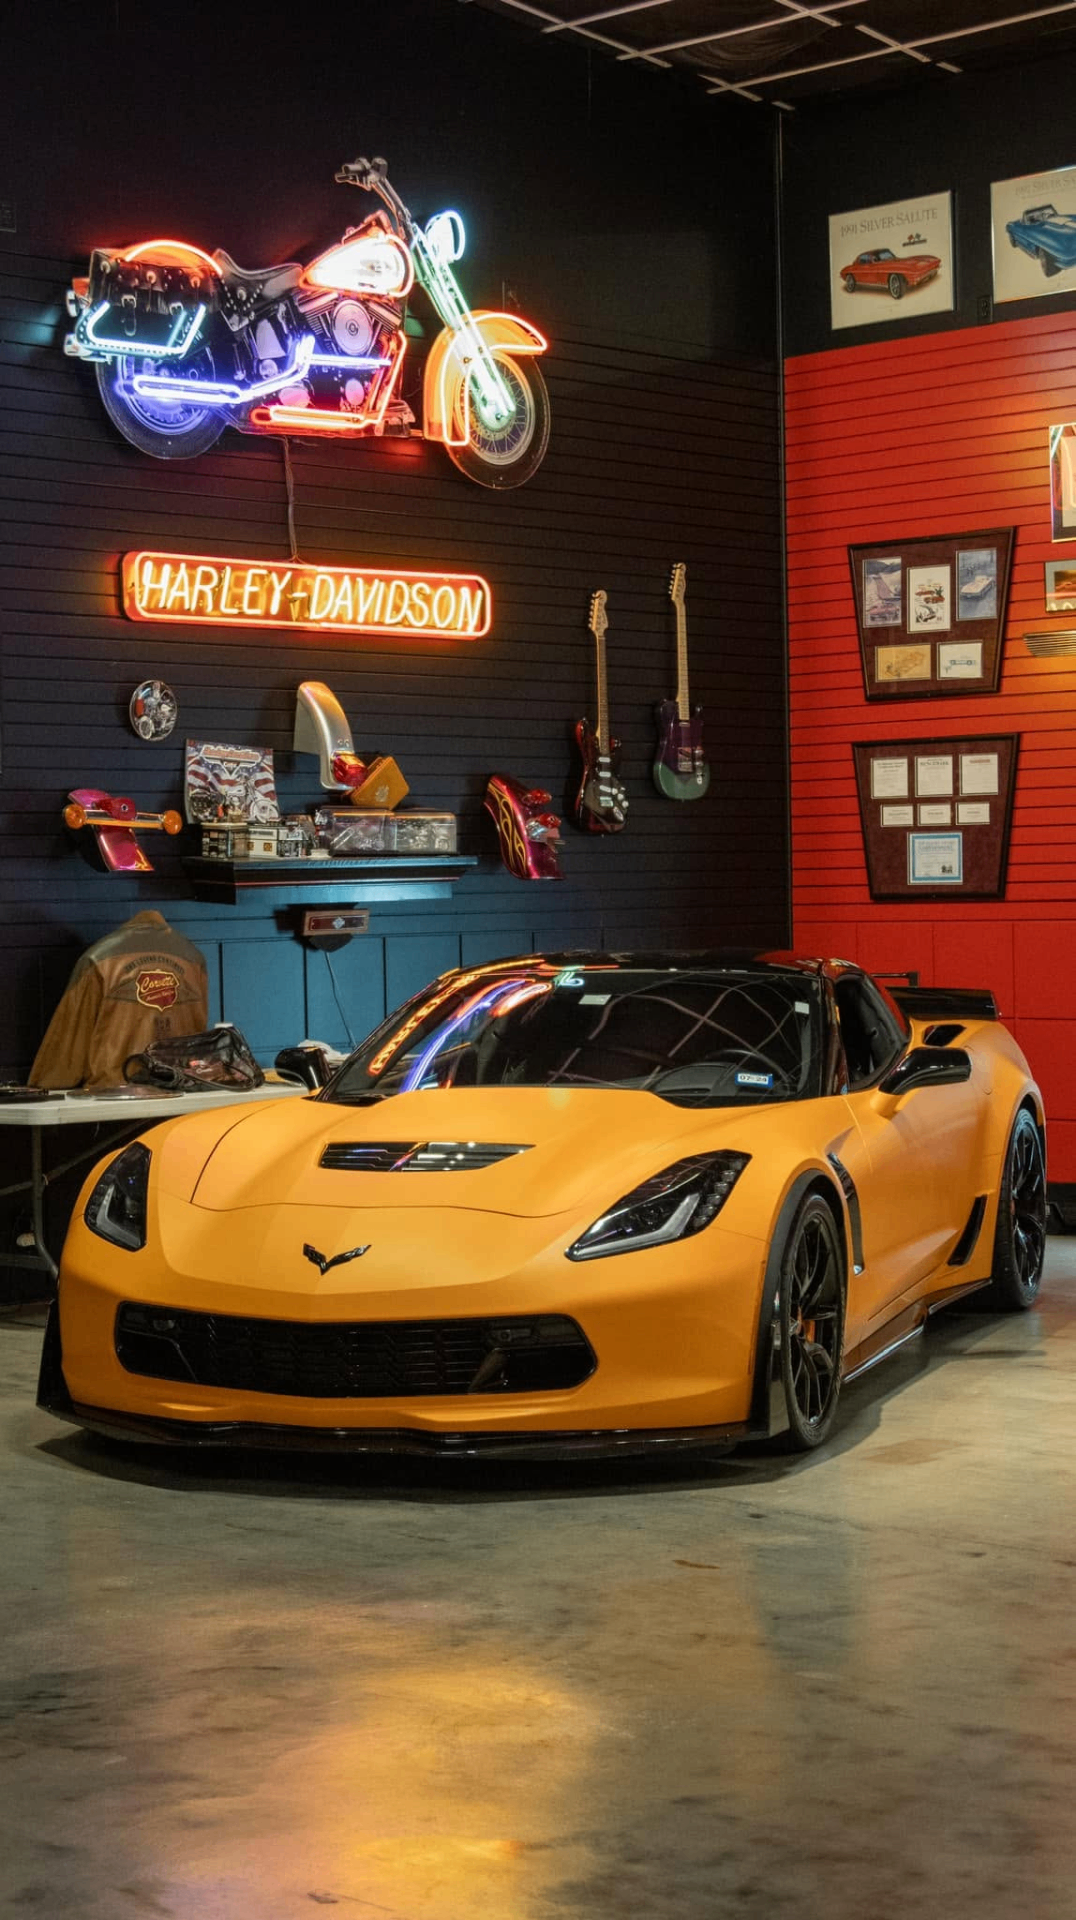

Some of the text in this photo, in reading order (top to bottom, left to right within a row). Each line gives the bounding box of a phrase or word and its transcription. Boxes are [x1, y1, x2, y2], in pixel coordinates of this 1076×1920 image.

[840, 208, 938, 238] 1991 SILVER SALUTE
[140, 560, 483, 634] HARLEY-DAVIDSON
